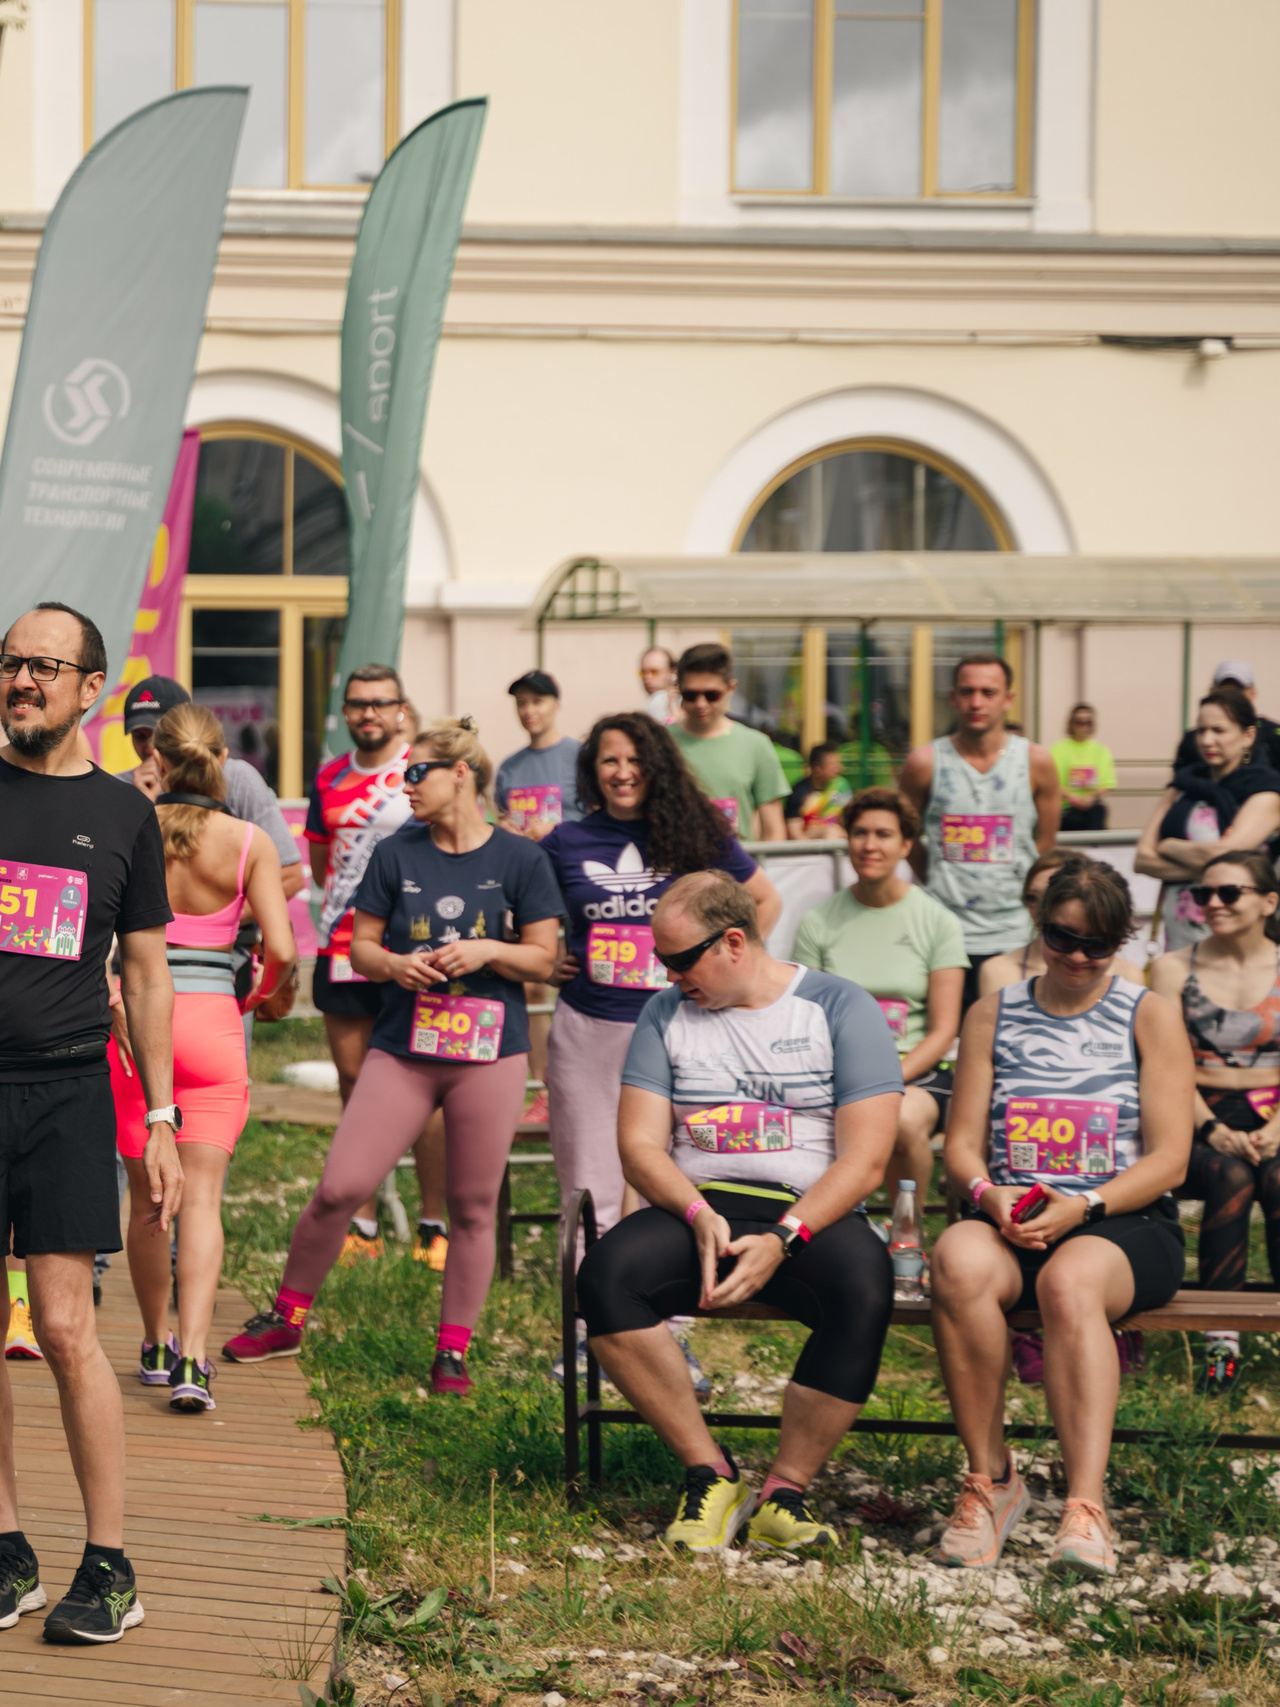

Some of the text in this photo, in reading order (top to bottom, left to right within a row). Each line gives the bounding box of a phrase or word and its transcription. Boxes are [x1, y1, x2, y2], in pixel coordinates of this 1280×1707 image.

[67, 889, 75, 900] 1
[583, 893, 658, 920] adida
[589, 938, 637, 963] 219
[415, 1007, 472, 1035] 340
[736, 1078, 786, 1103] RUN
[687, 1105, 744, 1124] 241
[1008, 1116, 1076, 1144] 240
